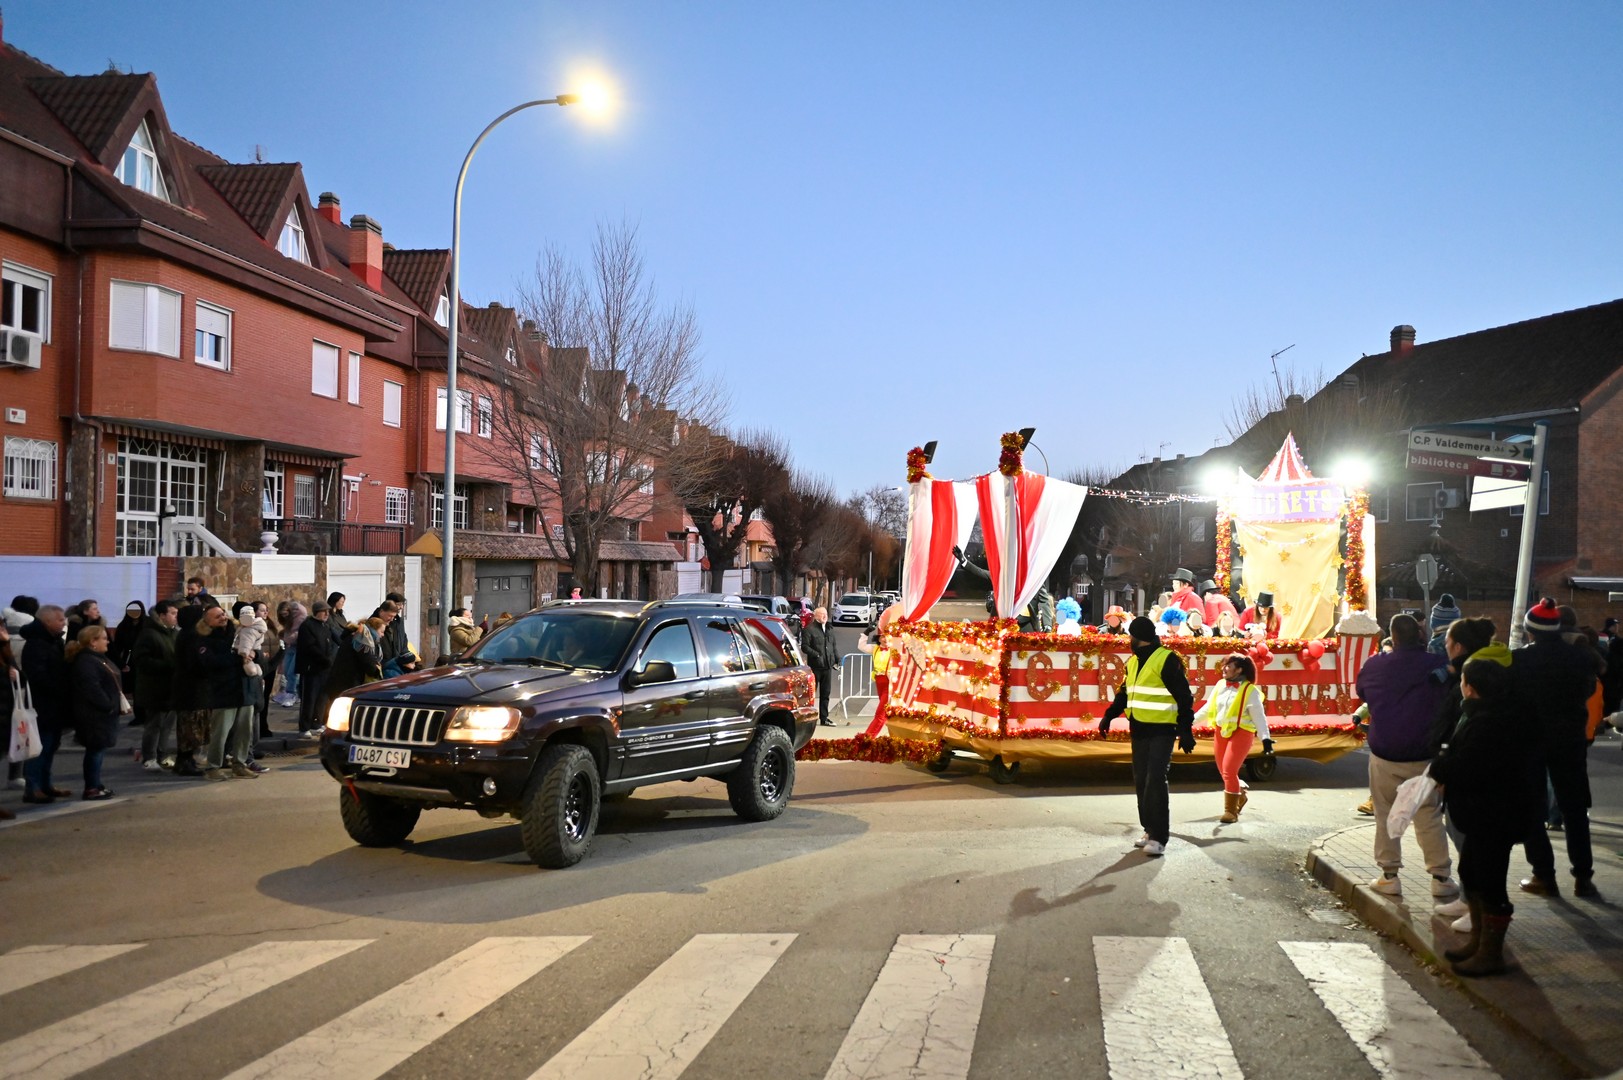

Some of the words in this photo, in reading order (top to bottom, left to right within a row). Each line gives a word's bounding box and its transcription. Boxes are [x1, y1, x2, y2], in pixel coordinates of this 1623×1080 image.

[1413, 435, 1431, 446] C.P.
[1435, 437, 1491, 452] Valdemera
[1411, 455, 1469, 470] biblioteca
[1247, 489, 1334, 515] ICKETS
[356, 748, 383, 763] 0487
[385, 750, 407, 766] CSV
